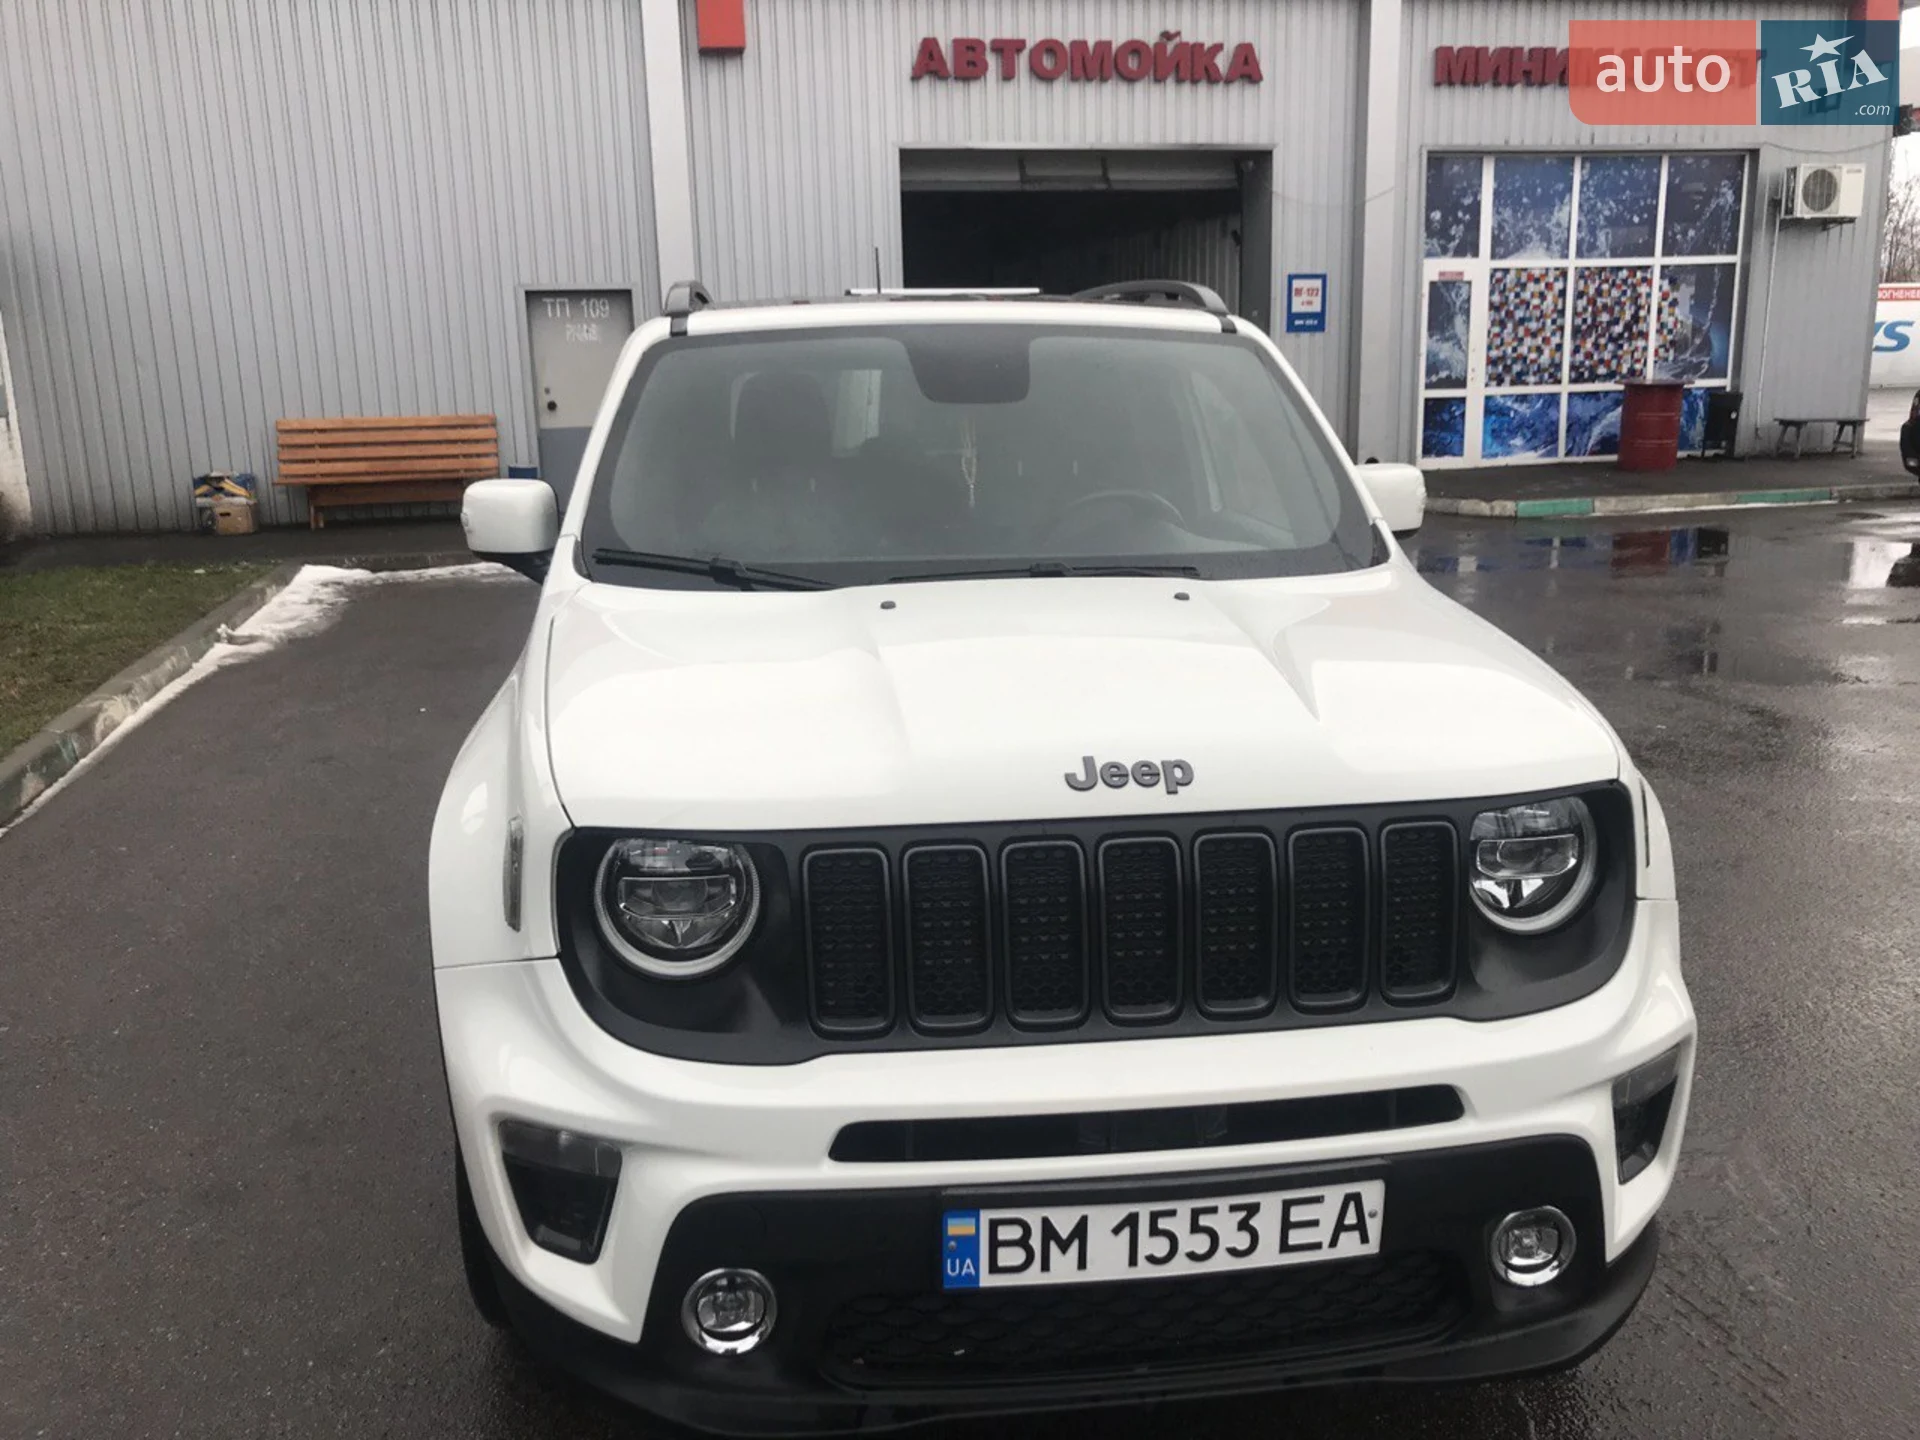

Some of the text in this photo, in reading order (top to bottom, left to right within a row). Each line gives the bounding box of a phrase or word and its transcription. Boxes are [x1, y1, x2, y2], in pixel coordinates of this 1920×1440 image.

[911, 30, 1264, 83] АВТОМОЙКА
[542, 297, 610, 318] ТП 109
[1064, 755, 1195, 795] Jeep
[988, 1191, 1370, 1275] BM 1553 EA
[946, 1257, 976, 1277] UA
